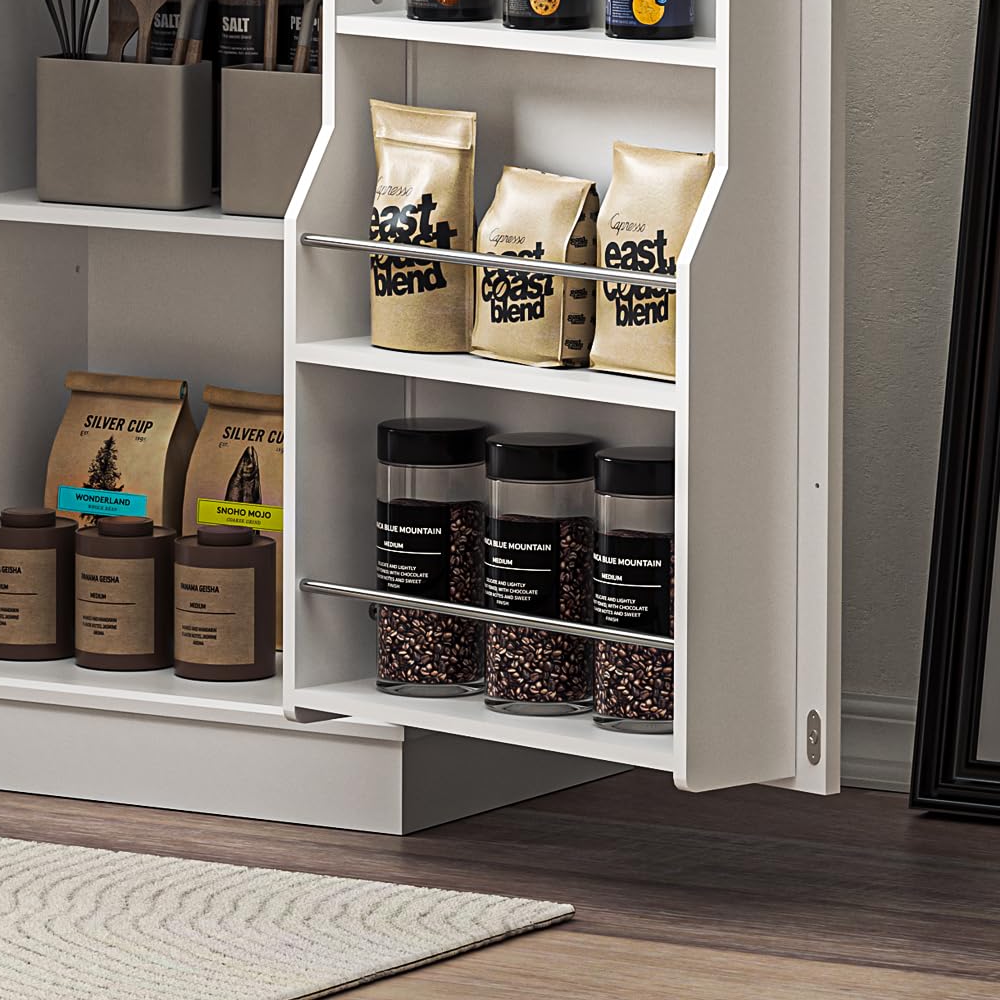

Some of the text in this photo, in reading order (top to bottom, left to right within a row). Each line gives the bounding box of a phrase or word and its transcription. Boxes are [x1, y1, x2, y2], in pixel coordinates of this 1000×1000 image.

[154, 13, 180, 28] SALT
[222, 16, 250, 32] SALT
[605, 230, 668, 272] east
[374, 263, 443, 296] blend
[490, 294, 545, 323] blend
[616, 292, 669, 327] blend
[84, 415, 153, 434] SILVER CUP
[223, 426, 284, 444] SILVER CU
[76, 493, 130, 506] WONDERLAND
[217, 506, 271, 519] SNOHO MOJO
[384, 524, 398, 532] BLUE
[400, 526, 441, 534] MOUNTAIN
[384, 540, 403, 549] MEDIUM
[493, 540, 551, 551] BLUE MOUNTAIN
[492, 557, 512, 565] MEDIUM
[602, 556, 661, 567] BLUE MOUNTAIN
[2, 566, 21, 574] GEISHA
[602, 573, 622, 582] MEDIUM
[199, 585, 219, 593] GEISHA
